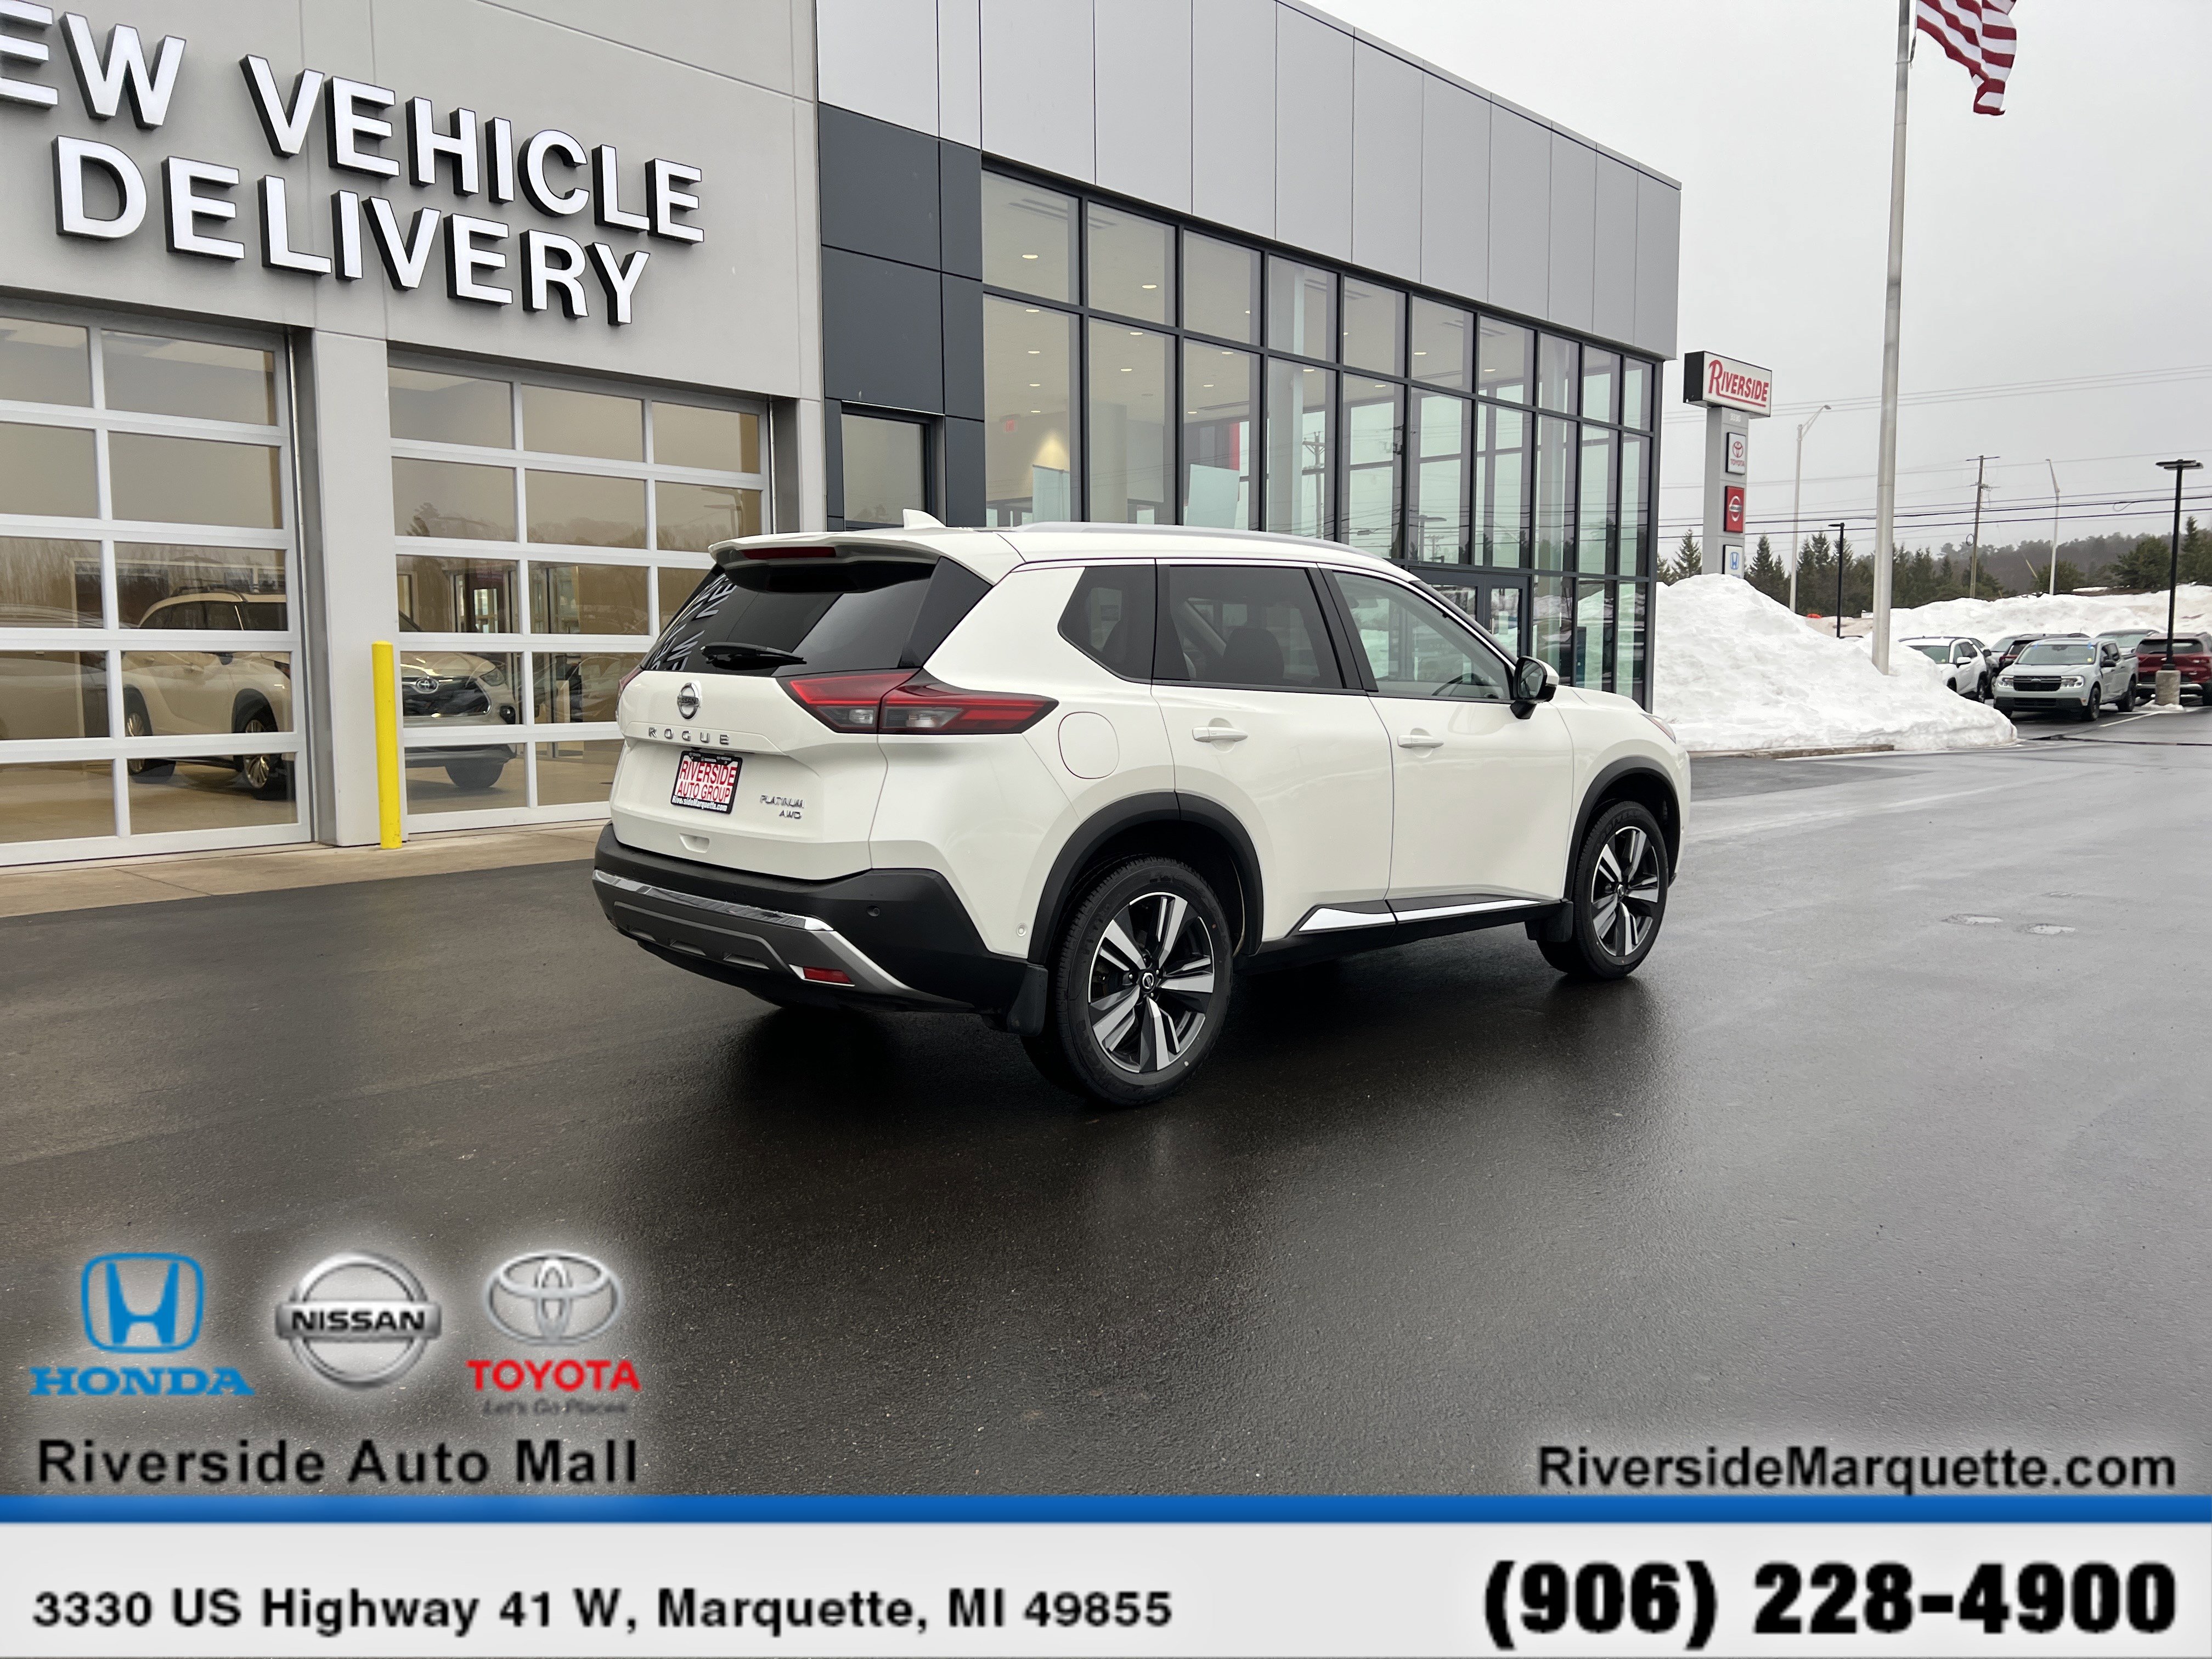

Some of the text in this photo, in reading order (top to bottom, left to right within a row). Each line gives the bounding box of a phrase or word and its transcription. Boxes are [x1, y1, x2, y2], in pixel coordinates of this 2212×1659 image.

[240, 54, 704, 244] VEHICLE
[51, 135, 651, 326] DELIVERY
[1708, 359, 1769, 403] RIVERSIDE
[648, 727, 730, 746] ROGUE
[680, 760, 738, 786] RIVERSIDE
[677, 781, 730, 804] AUTO GROUP
[760, 794, 805, 809] PLATINUM
[779, 810, 802, 819] AWD
